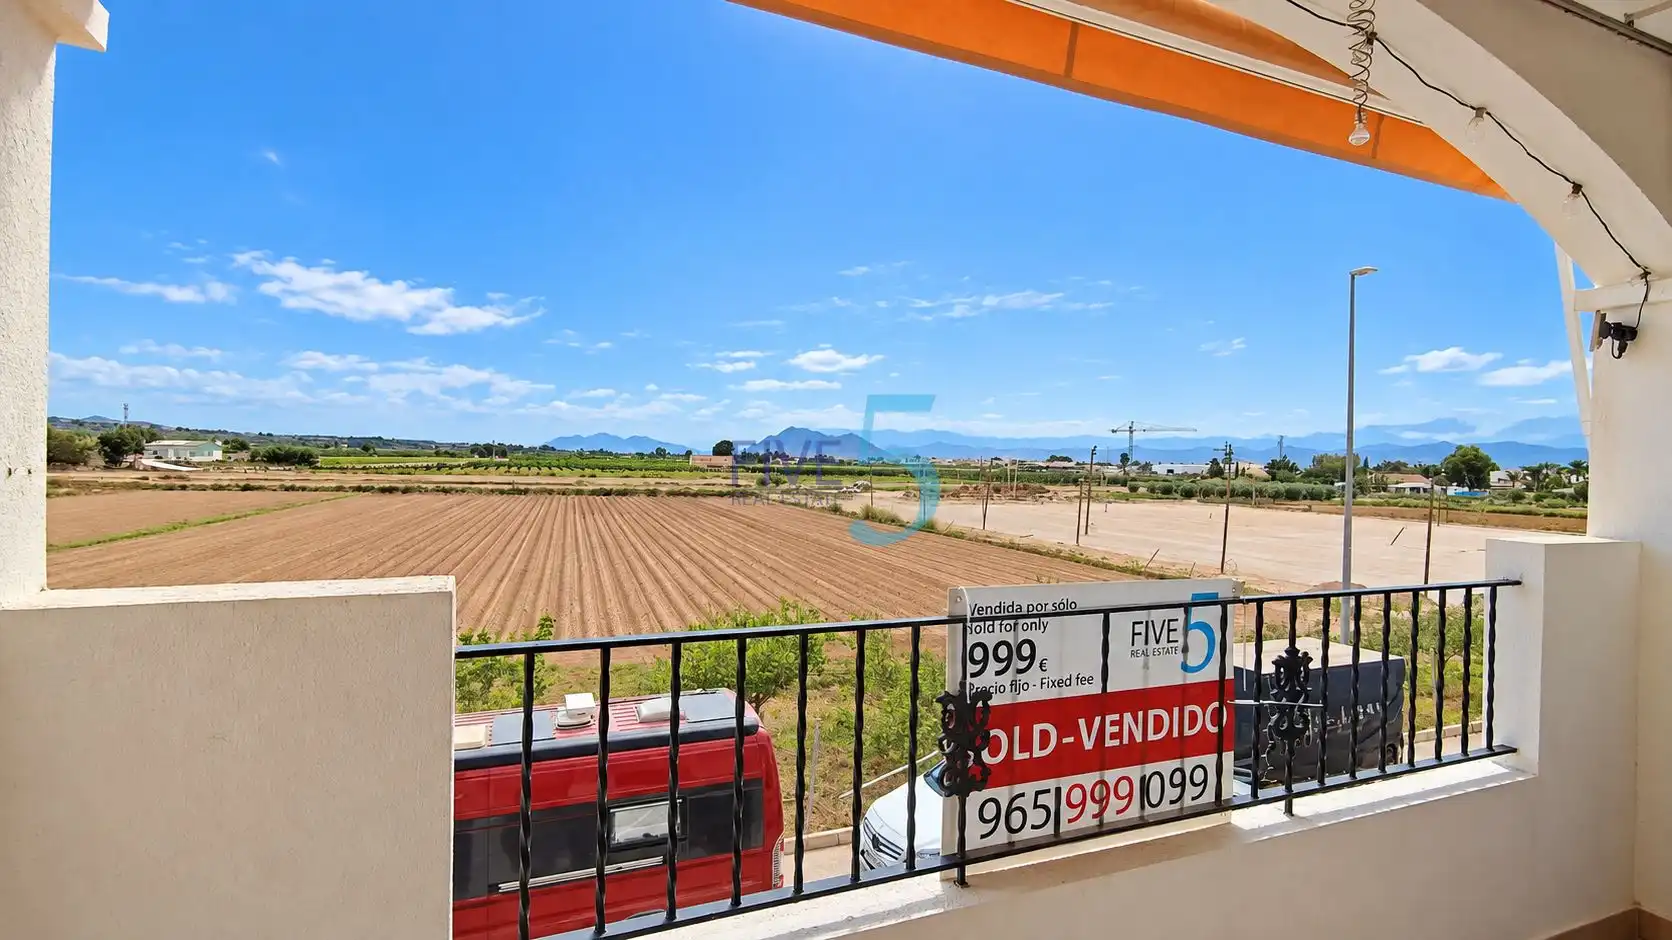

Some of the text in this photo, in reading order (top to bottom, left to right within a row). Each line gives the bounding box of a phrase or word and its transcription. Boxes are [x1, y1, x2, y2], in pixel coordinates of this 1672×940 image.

[970, 598, 1077, 616] Vendida por sólo
[1000, 620, 1018, 633] for
[1022, 618, 1049, 633] only
[1131, 618, 1179, 646] FIVE
[1181, 592, 1219, 674] 5
[968, 638, 1048, 679] 999 €
[1130, 646, 1179, 658] REAL ESTATE
[969, 681, 1006, 698] Precio
[1040, 674, 1072, 689] Fixed
[1075, 672, 1094, 685] fee
[967, 701, 1228, 767] OLD-VENDIDO
